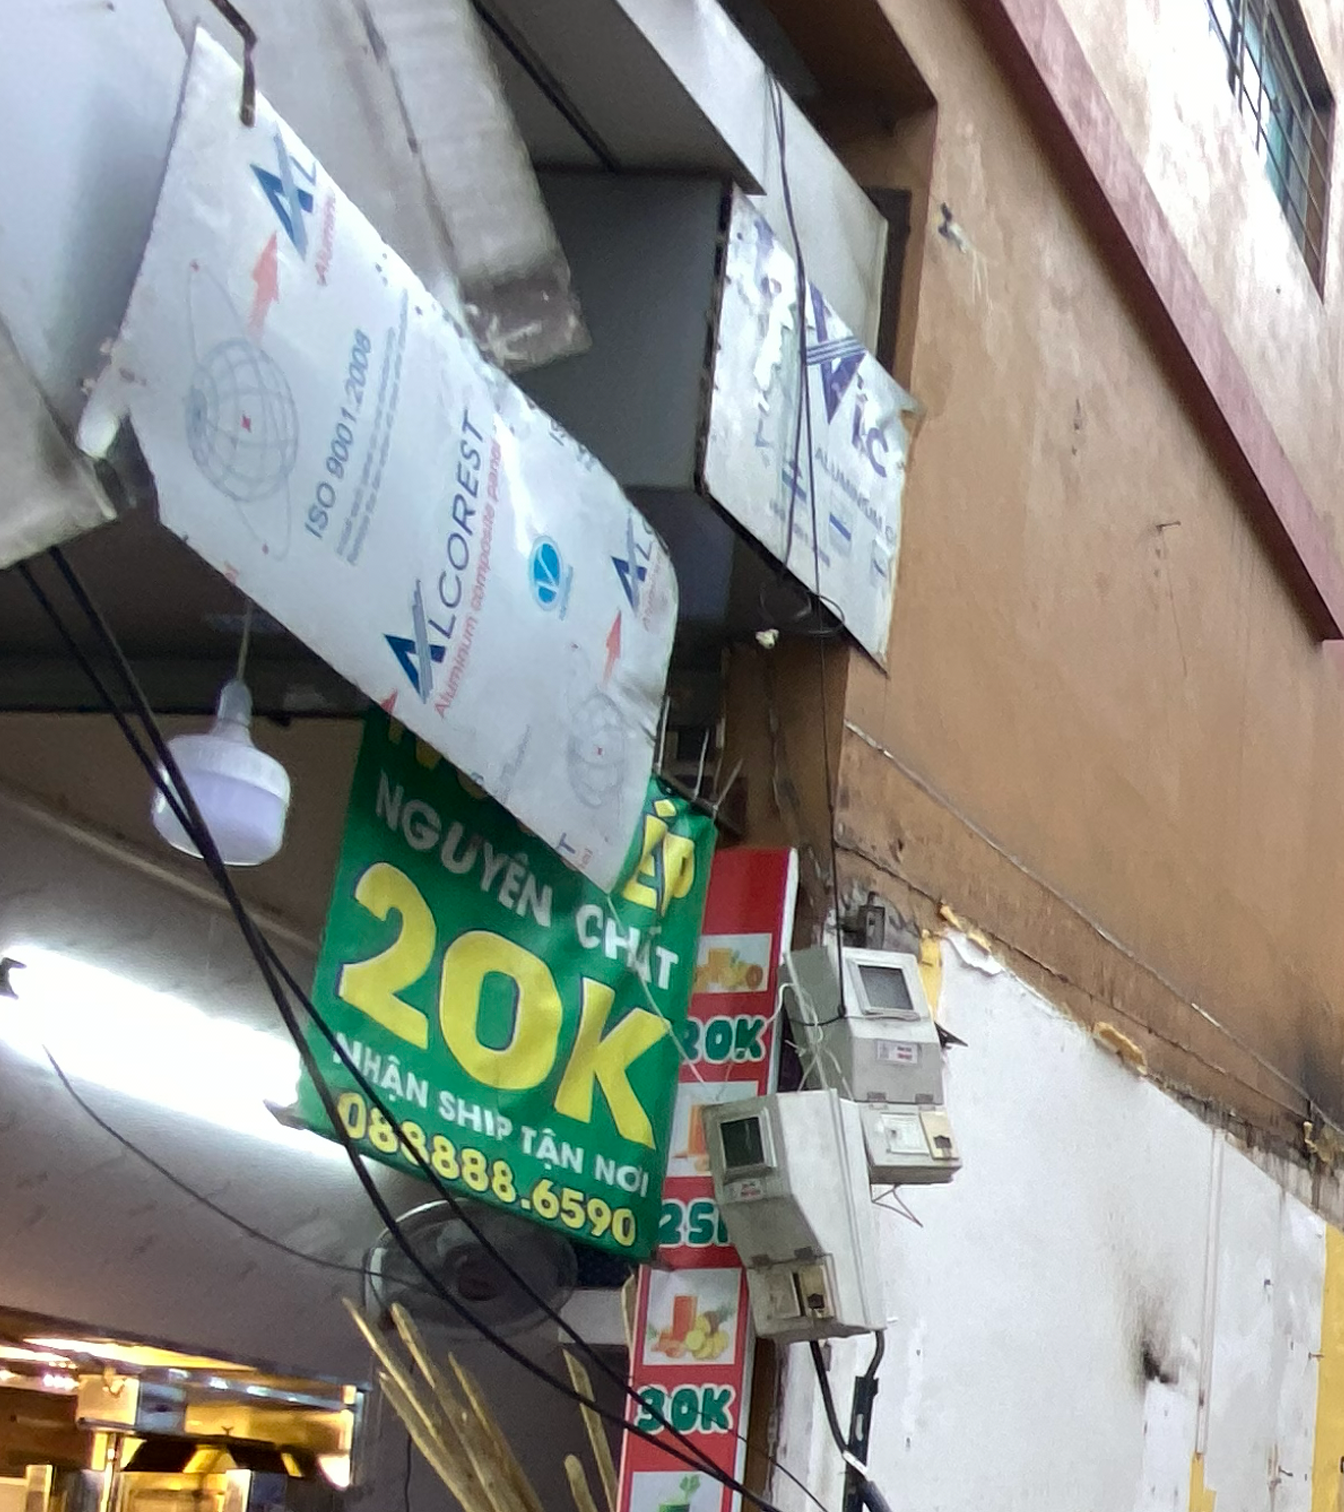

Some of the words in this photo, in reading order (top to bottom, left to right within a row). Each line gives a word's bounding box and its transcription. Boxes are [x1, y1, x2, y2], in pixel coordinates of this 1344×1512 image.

[305, 481, 336, 540] ISO
[383, 407, 484, 704] ALCOREST
[469, 503, 496, 612] composite
[375, 768, 552, 927] NGUYÊN
[337, 862, 671, 1150] 20K
[332, 1032, 429, 1108] NHẬN
[438, 1090, 513, 1141] SHIP
[521, 1126, 584, 1174] TẬN
[338, 1092, 636, 1246] 088888.6590
[635, 1385, 736, 1434] 30K
